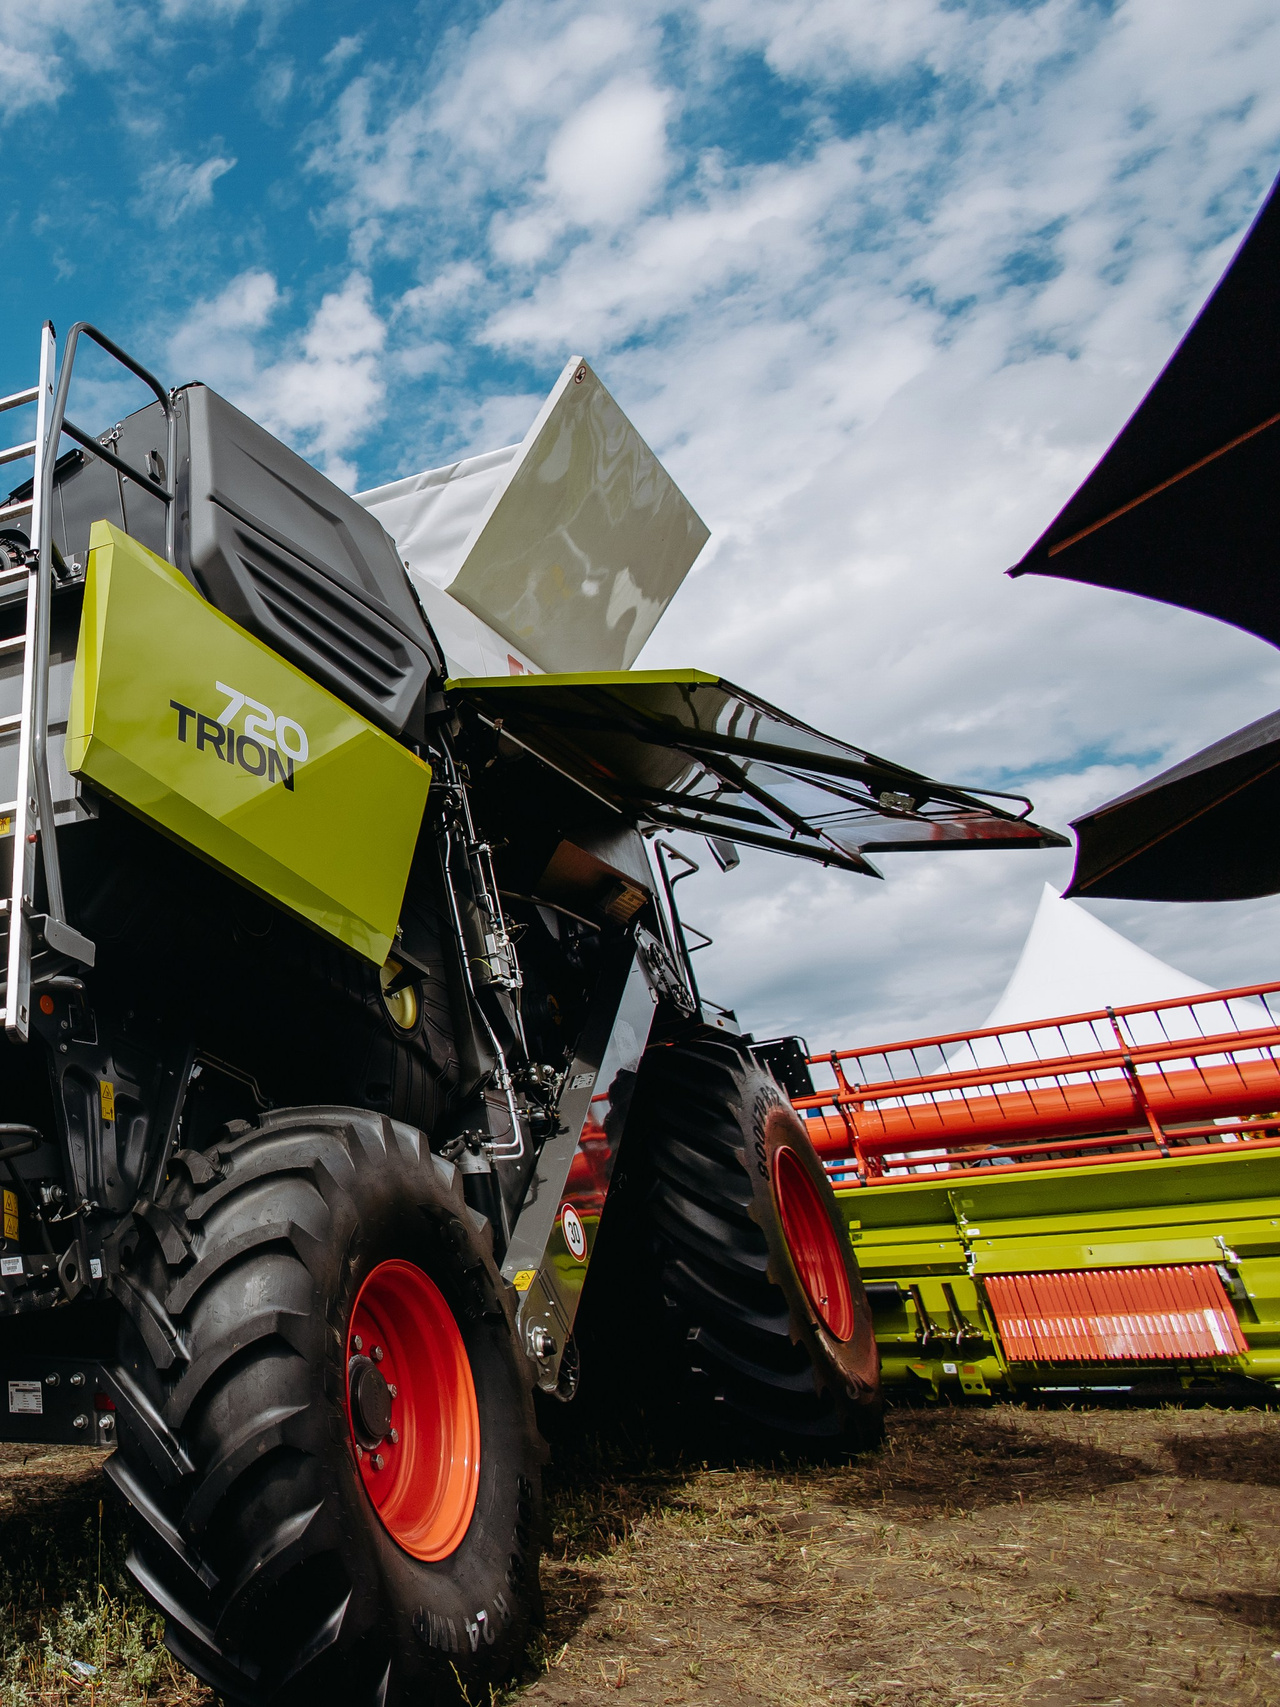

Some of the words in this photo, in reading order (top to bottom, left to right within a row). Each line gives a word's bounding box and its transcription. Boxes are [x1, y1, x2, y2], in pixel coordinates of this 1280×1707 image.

[170, 699, 294, 792] TRION
[216, 680, 309, 763] 720
[568, 1221, 581, 1244] 30
